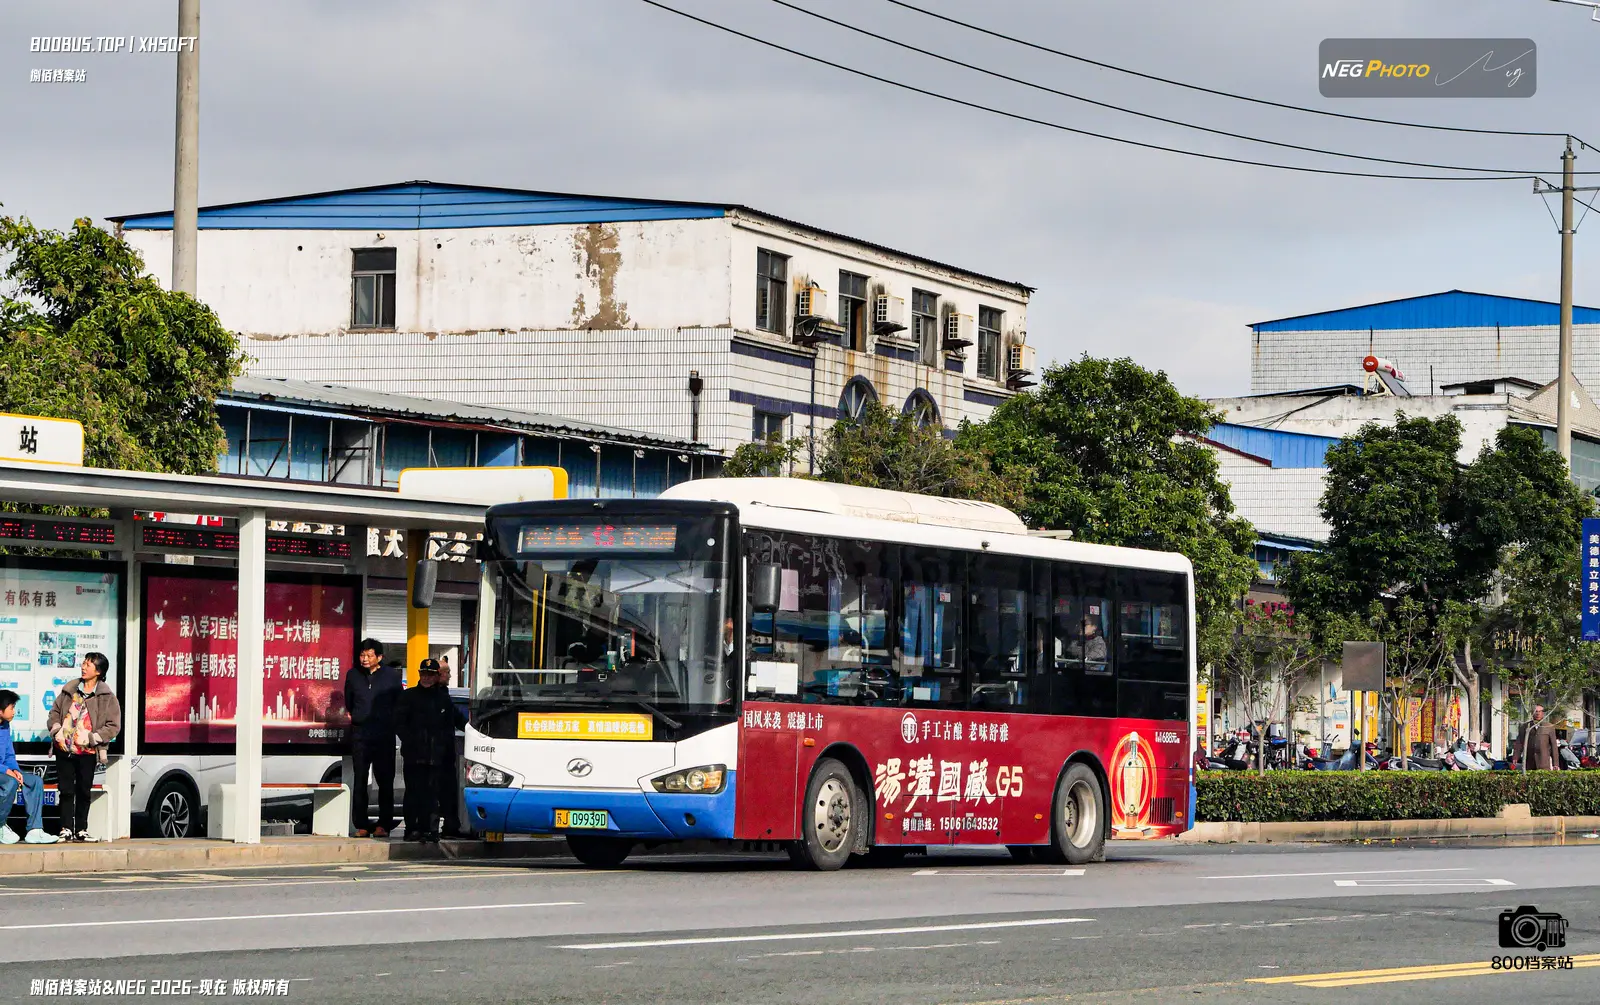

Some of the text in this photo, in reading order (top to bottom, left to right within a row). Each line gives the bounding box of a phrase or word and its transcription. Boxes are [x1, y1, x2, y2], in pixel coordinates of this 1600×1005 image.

[19, 425, 38, 454] 站
[1589, 534, 1600, 615] 美德是立身之本
[5, 589, 57, 607] 有你有我
[743, 710, 824, 731] 国风来袭 震撼上市
[921, 720, 963, 740] 手工古酿
[968, 721, 1009, 742] 老味舒雅
[939, 817, 999, 831] 15061643532
